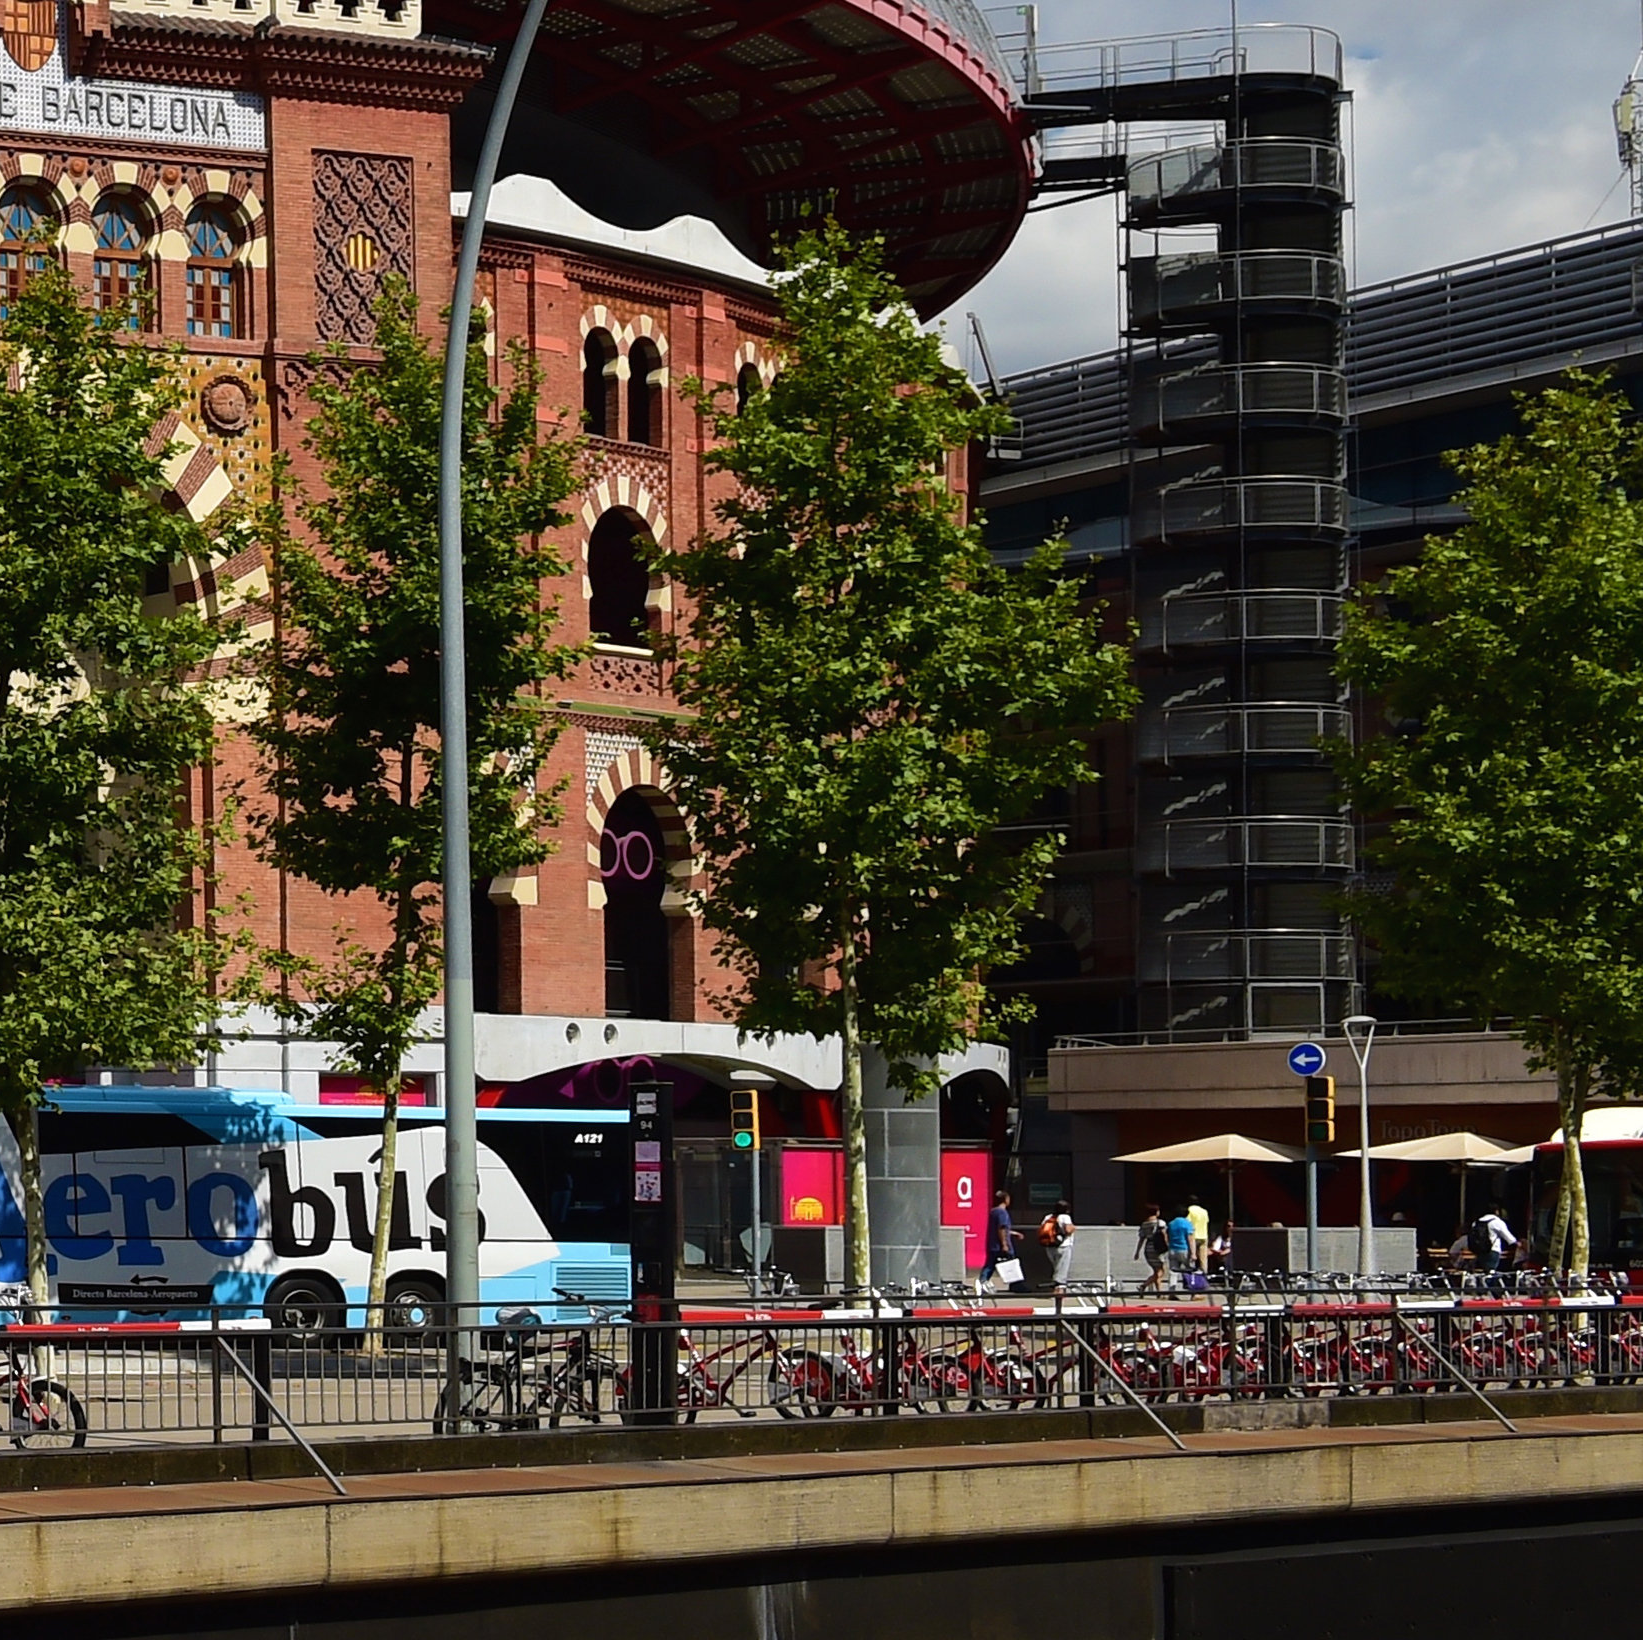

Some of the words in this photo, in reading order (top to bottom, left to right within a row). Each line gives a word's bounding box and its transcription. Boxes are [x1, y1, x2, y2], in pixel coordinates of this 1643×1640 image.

[43, 84, 232, 139] BARCELONA
[640, 1120, 653, 1129] 94
[574, 1133, 604, 1144] A121
[72, 1288, 104, 1298] Directo
[107, 1288, 198, 1300] Barcelona-Aeropuerto
